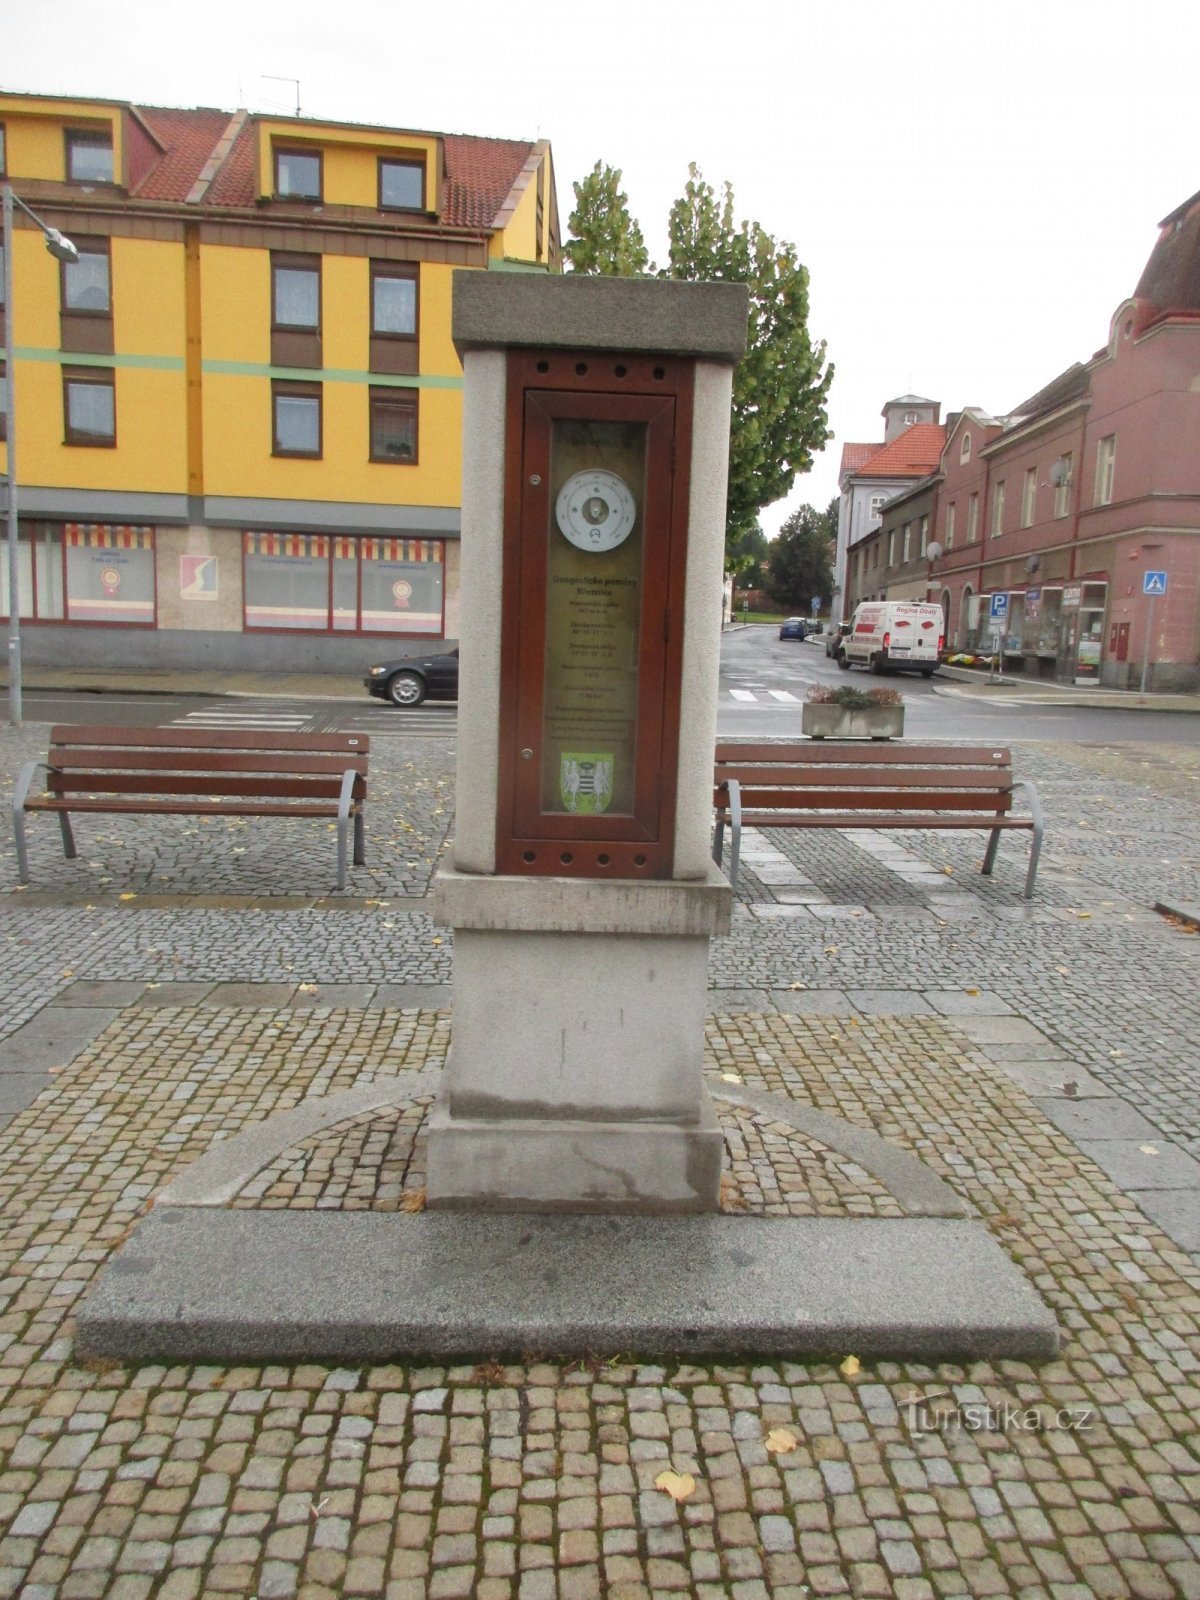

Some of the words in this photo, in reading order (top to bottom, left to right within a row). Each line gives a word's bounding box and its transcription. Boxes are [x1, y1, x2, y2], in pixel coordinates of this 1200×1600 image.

[994, 595, 1005, 610] P
[896, 606, 918, 615] Regina
[919, 608, 938, 616] Obaly
